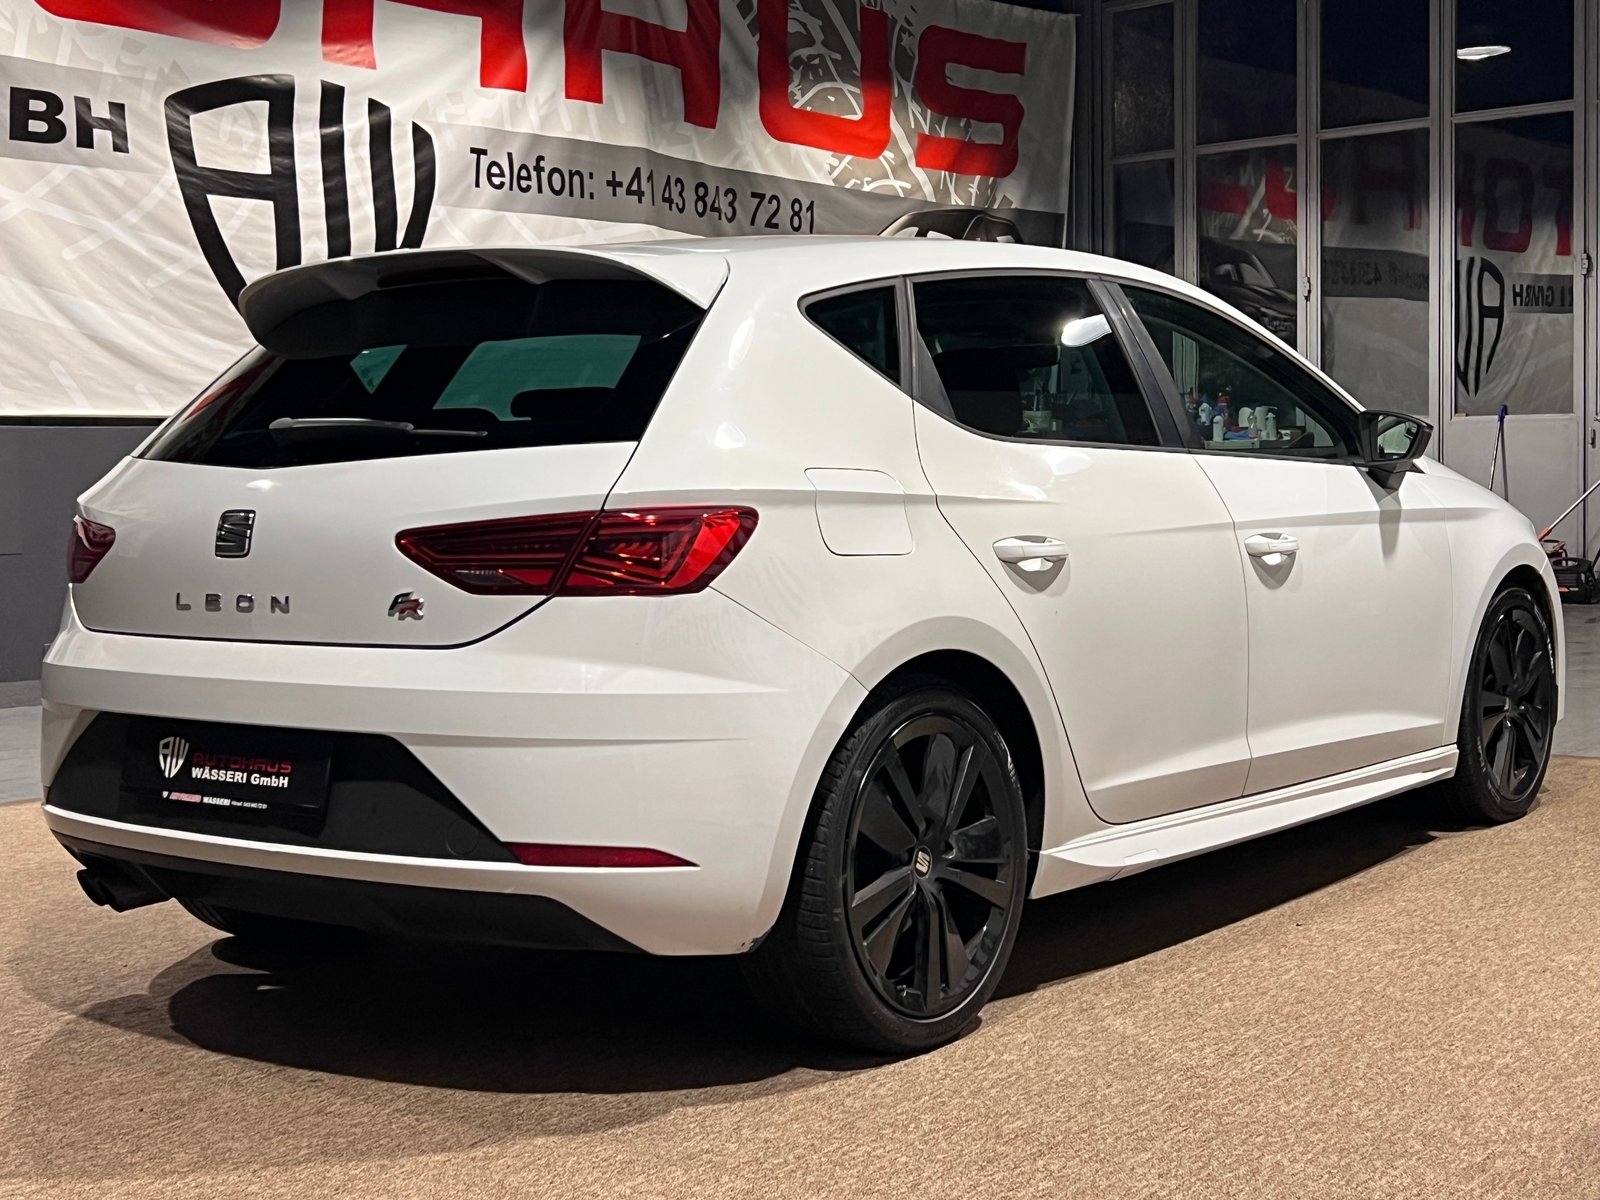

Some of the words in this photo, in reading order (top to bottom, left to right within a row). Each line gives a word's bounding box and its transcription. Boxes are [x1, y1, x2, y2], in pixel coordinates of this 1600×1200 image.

[34, 0, 1027, 178] AUS
[470, 147, 595, 200] Telefon:
[694, 181, 737, 223] 843
[750, 191, 781, 230] 72
[790, 198, 815, 234] 81
[176, 592, 290, 614] LEON
[388, 590, 424, 621] FR
[192, 752, 292, 774] AUTOHAUS
[191, 767, 247, 784] WÄSSERI
[250, 773, 289, 788] GmbH
